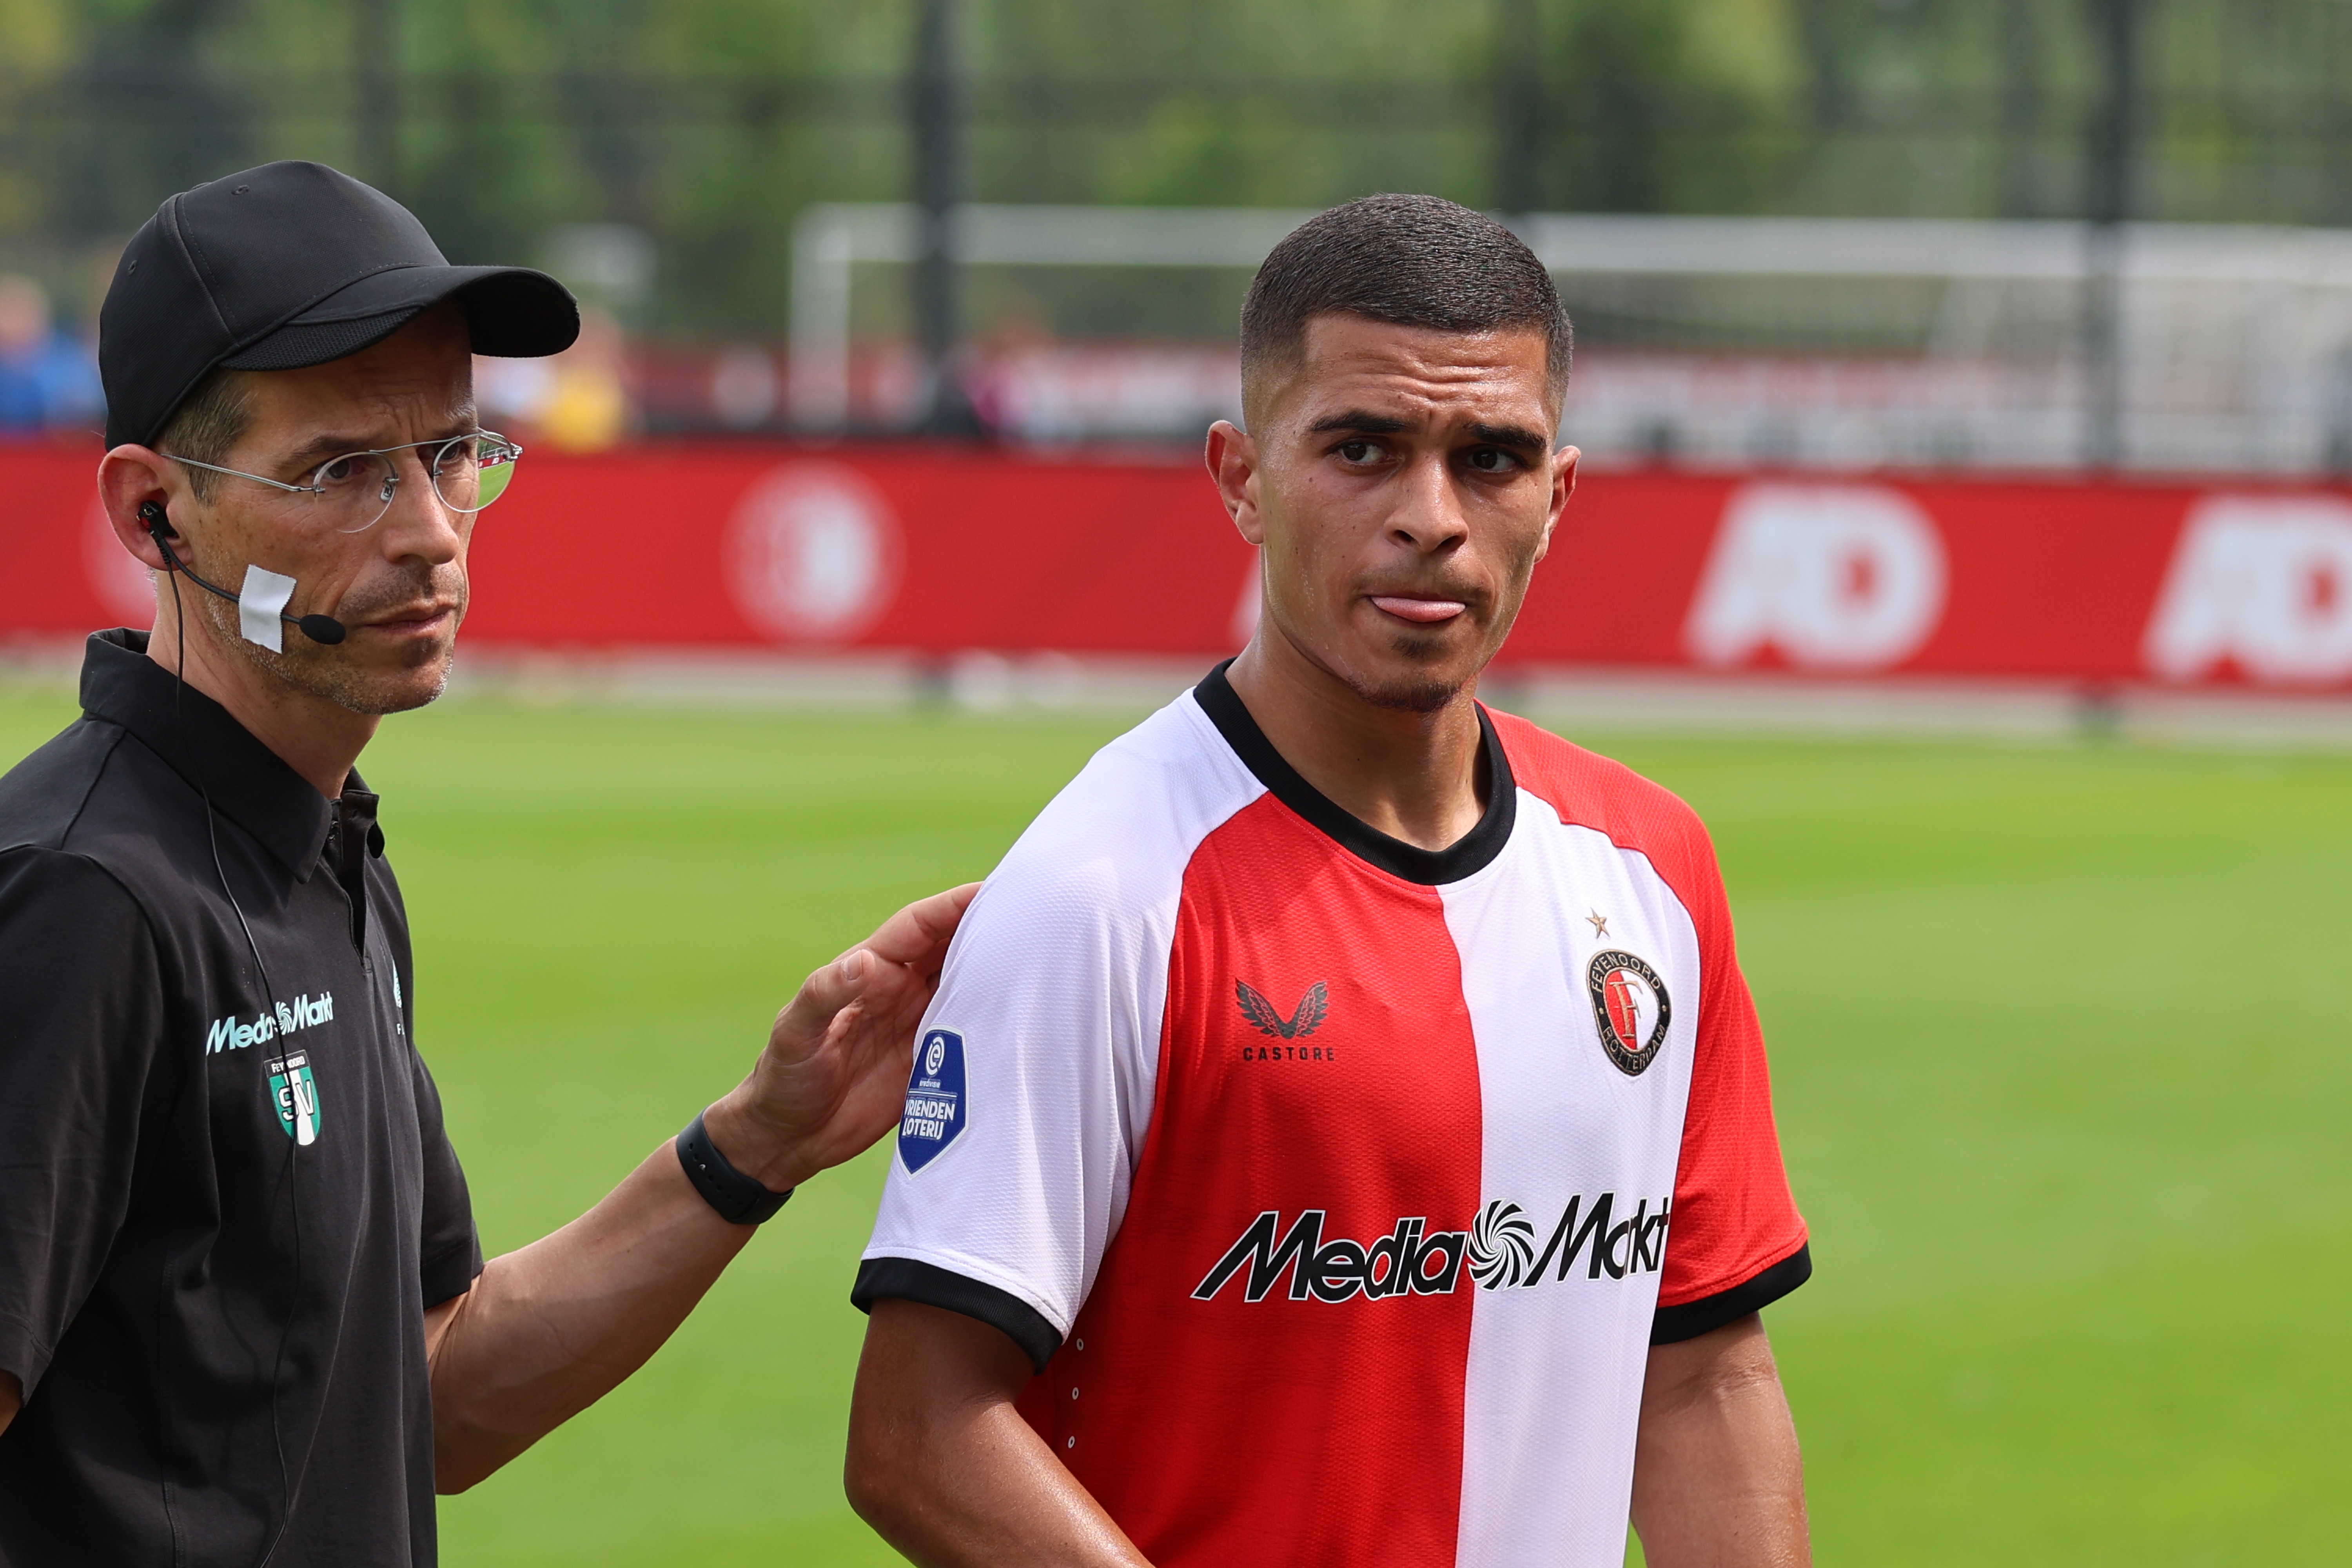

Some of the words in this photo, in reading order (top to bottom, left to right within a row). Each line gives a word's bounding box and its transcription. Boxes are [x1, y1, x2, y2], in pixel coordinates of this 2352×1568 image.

[1682, 481, 1950, 672] AD
[2140, 492, 2352, 683] AD
[1592, 953, 1661, 993] FEYENOORD
[206, 1013, 273, 1056] Meda
[291, 991, 333, 1033] Markt
[271, 1055, 305, 1073] FEYNOORD
[1243, 1047, 1334, 1061] CASTORE
[1603, 1024, 1665, 1070] ROTTERDAM
[278, 1079, 314, 1122] SV
[904, 1099, 955, 1121] VRIENDEN
[902, 1118, 944, 1140] LOTERIJ
[1190, 1209, 1467, 1303] Media
